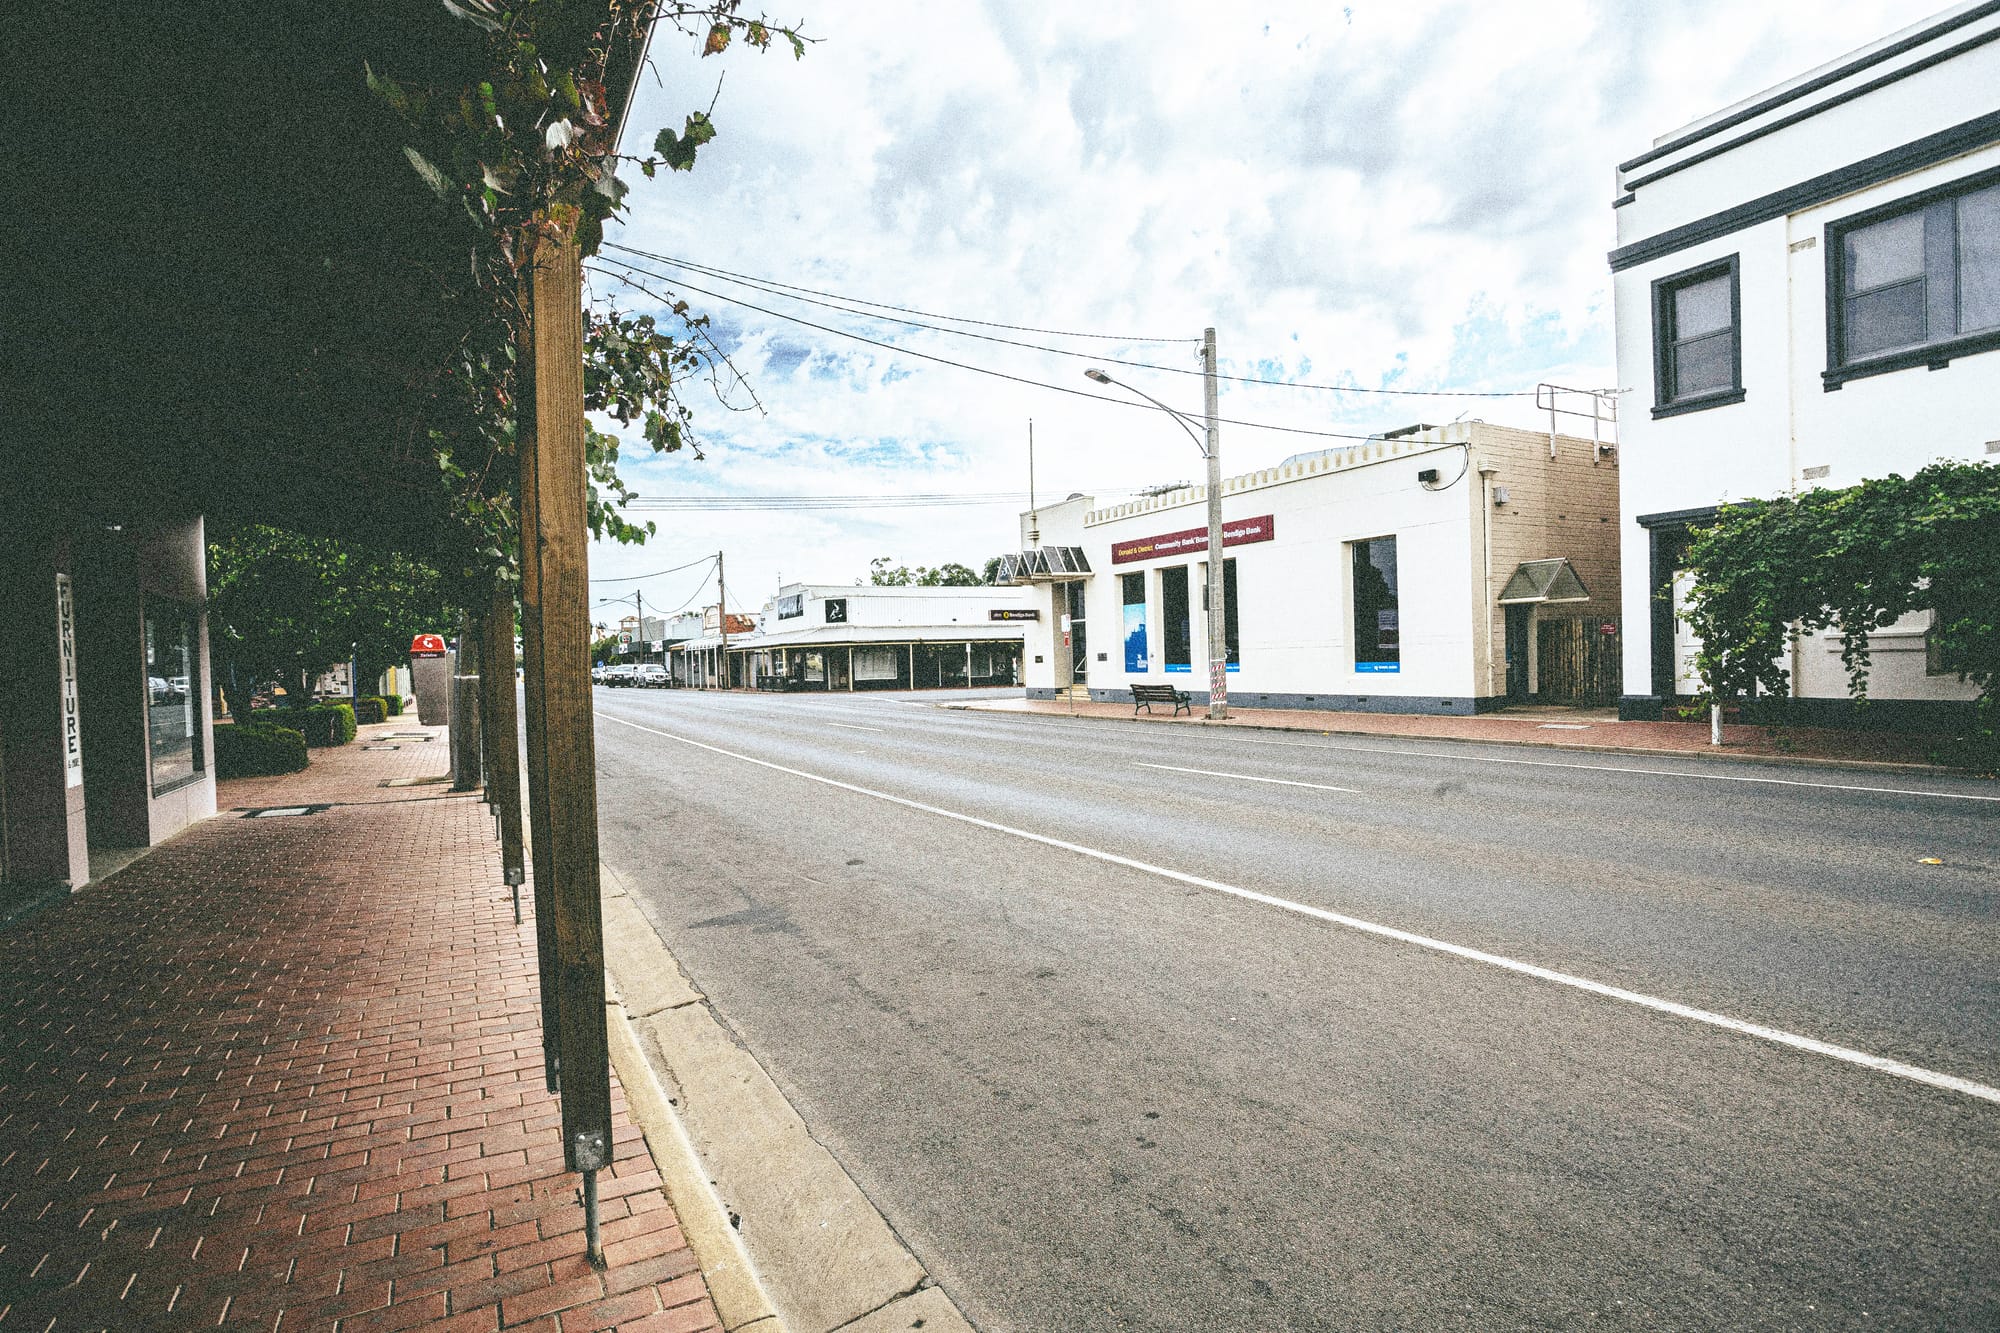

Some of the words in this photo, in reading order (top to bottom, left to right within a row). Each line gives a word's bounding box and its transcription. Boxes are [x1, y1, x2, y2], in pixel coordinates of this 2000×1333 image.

[1181, 537, 1194, 546] Bank
[1223, 528, 1246, 539] Bendigo
[1246, 525, 1262, 535] Bank
[61, 582, 77, 754] FURNITURE
